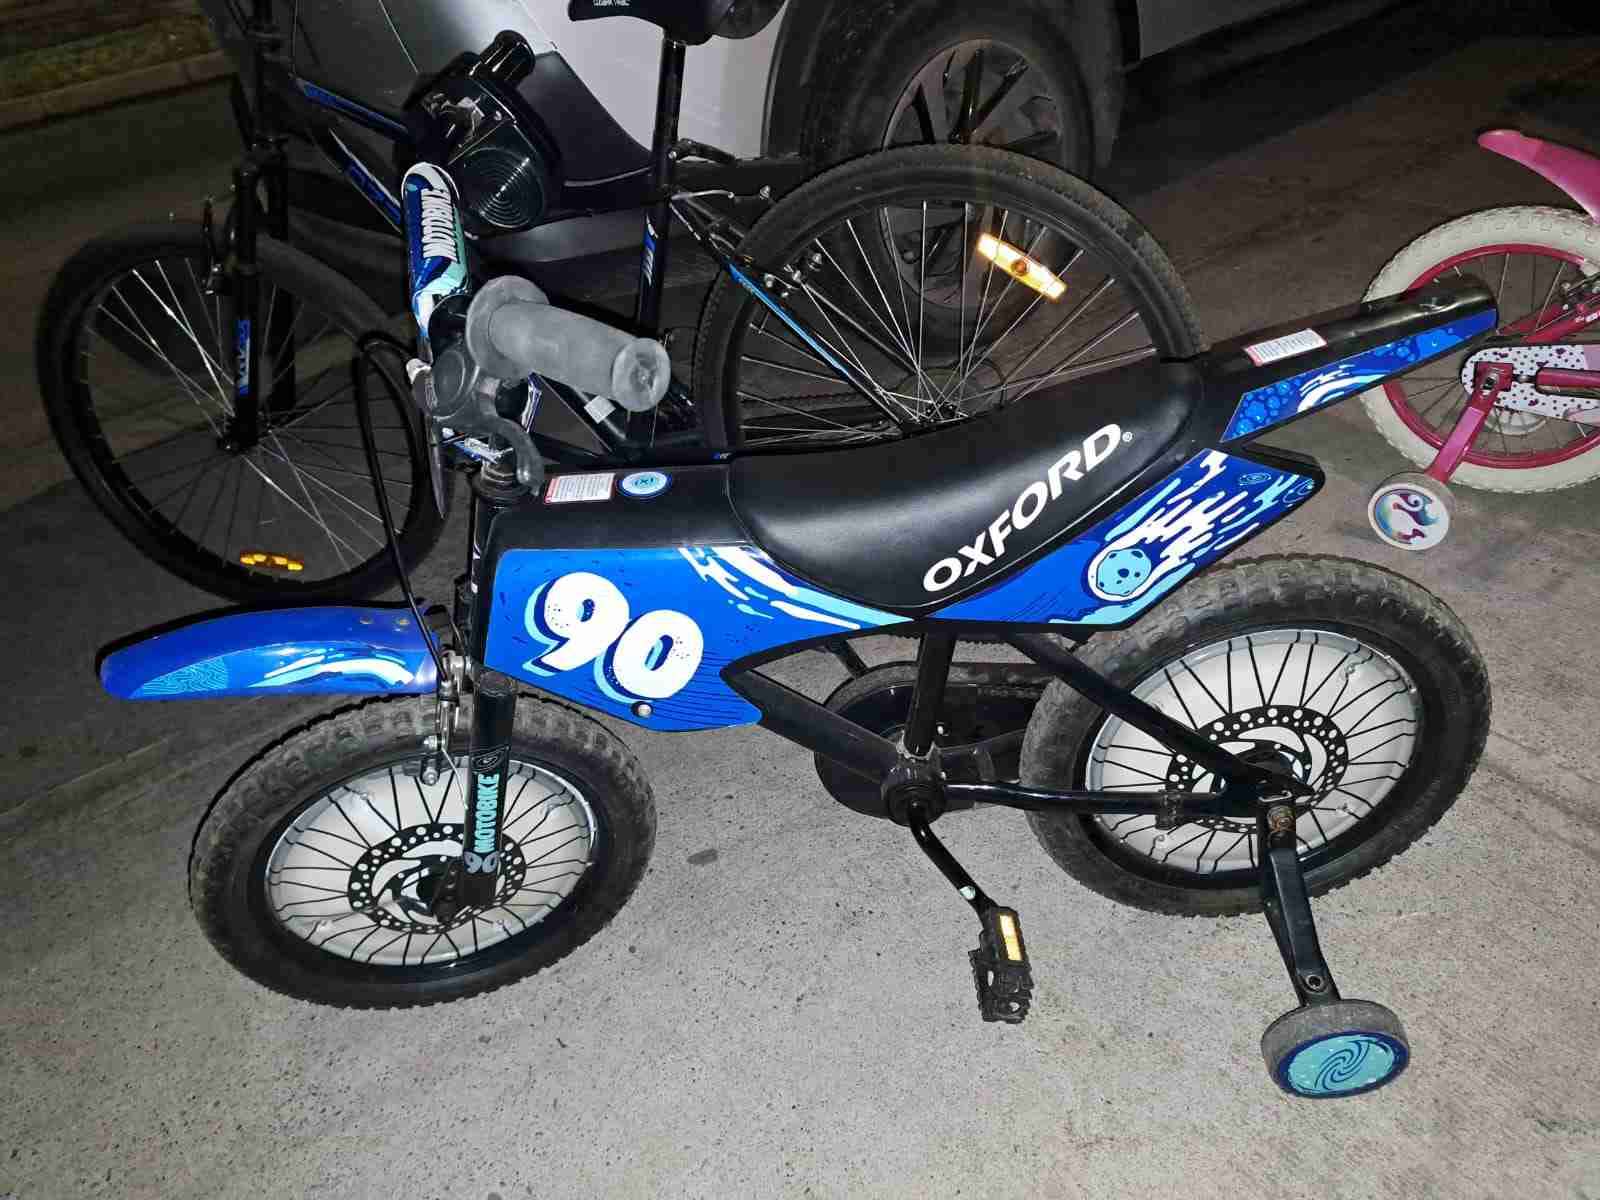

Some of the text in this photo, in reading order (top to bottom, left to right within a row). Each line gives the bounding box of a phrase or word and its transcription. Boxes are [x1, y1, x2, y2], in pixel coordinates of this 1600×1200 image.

[523, 571, 704, 703] 90
[473, 773, 500, 854] MOTOBIKE
[464, 850, 500, 875] 90
